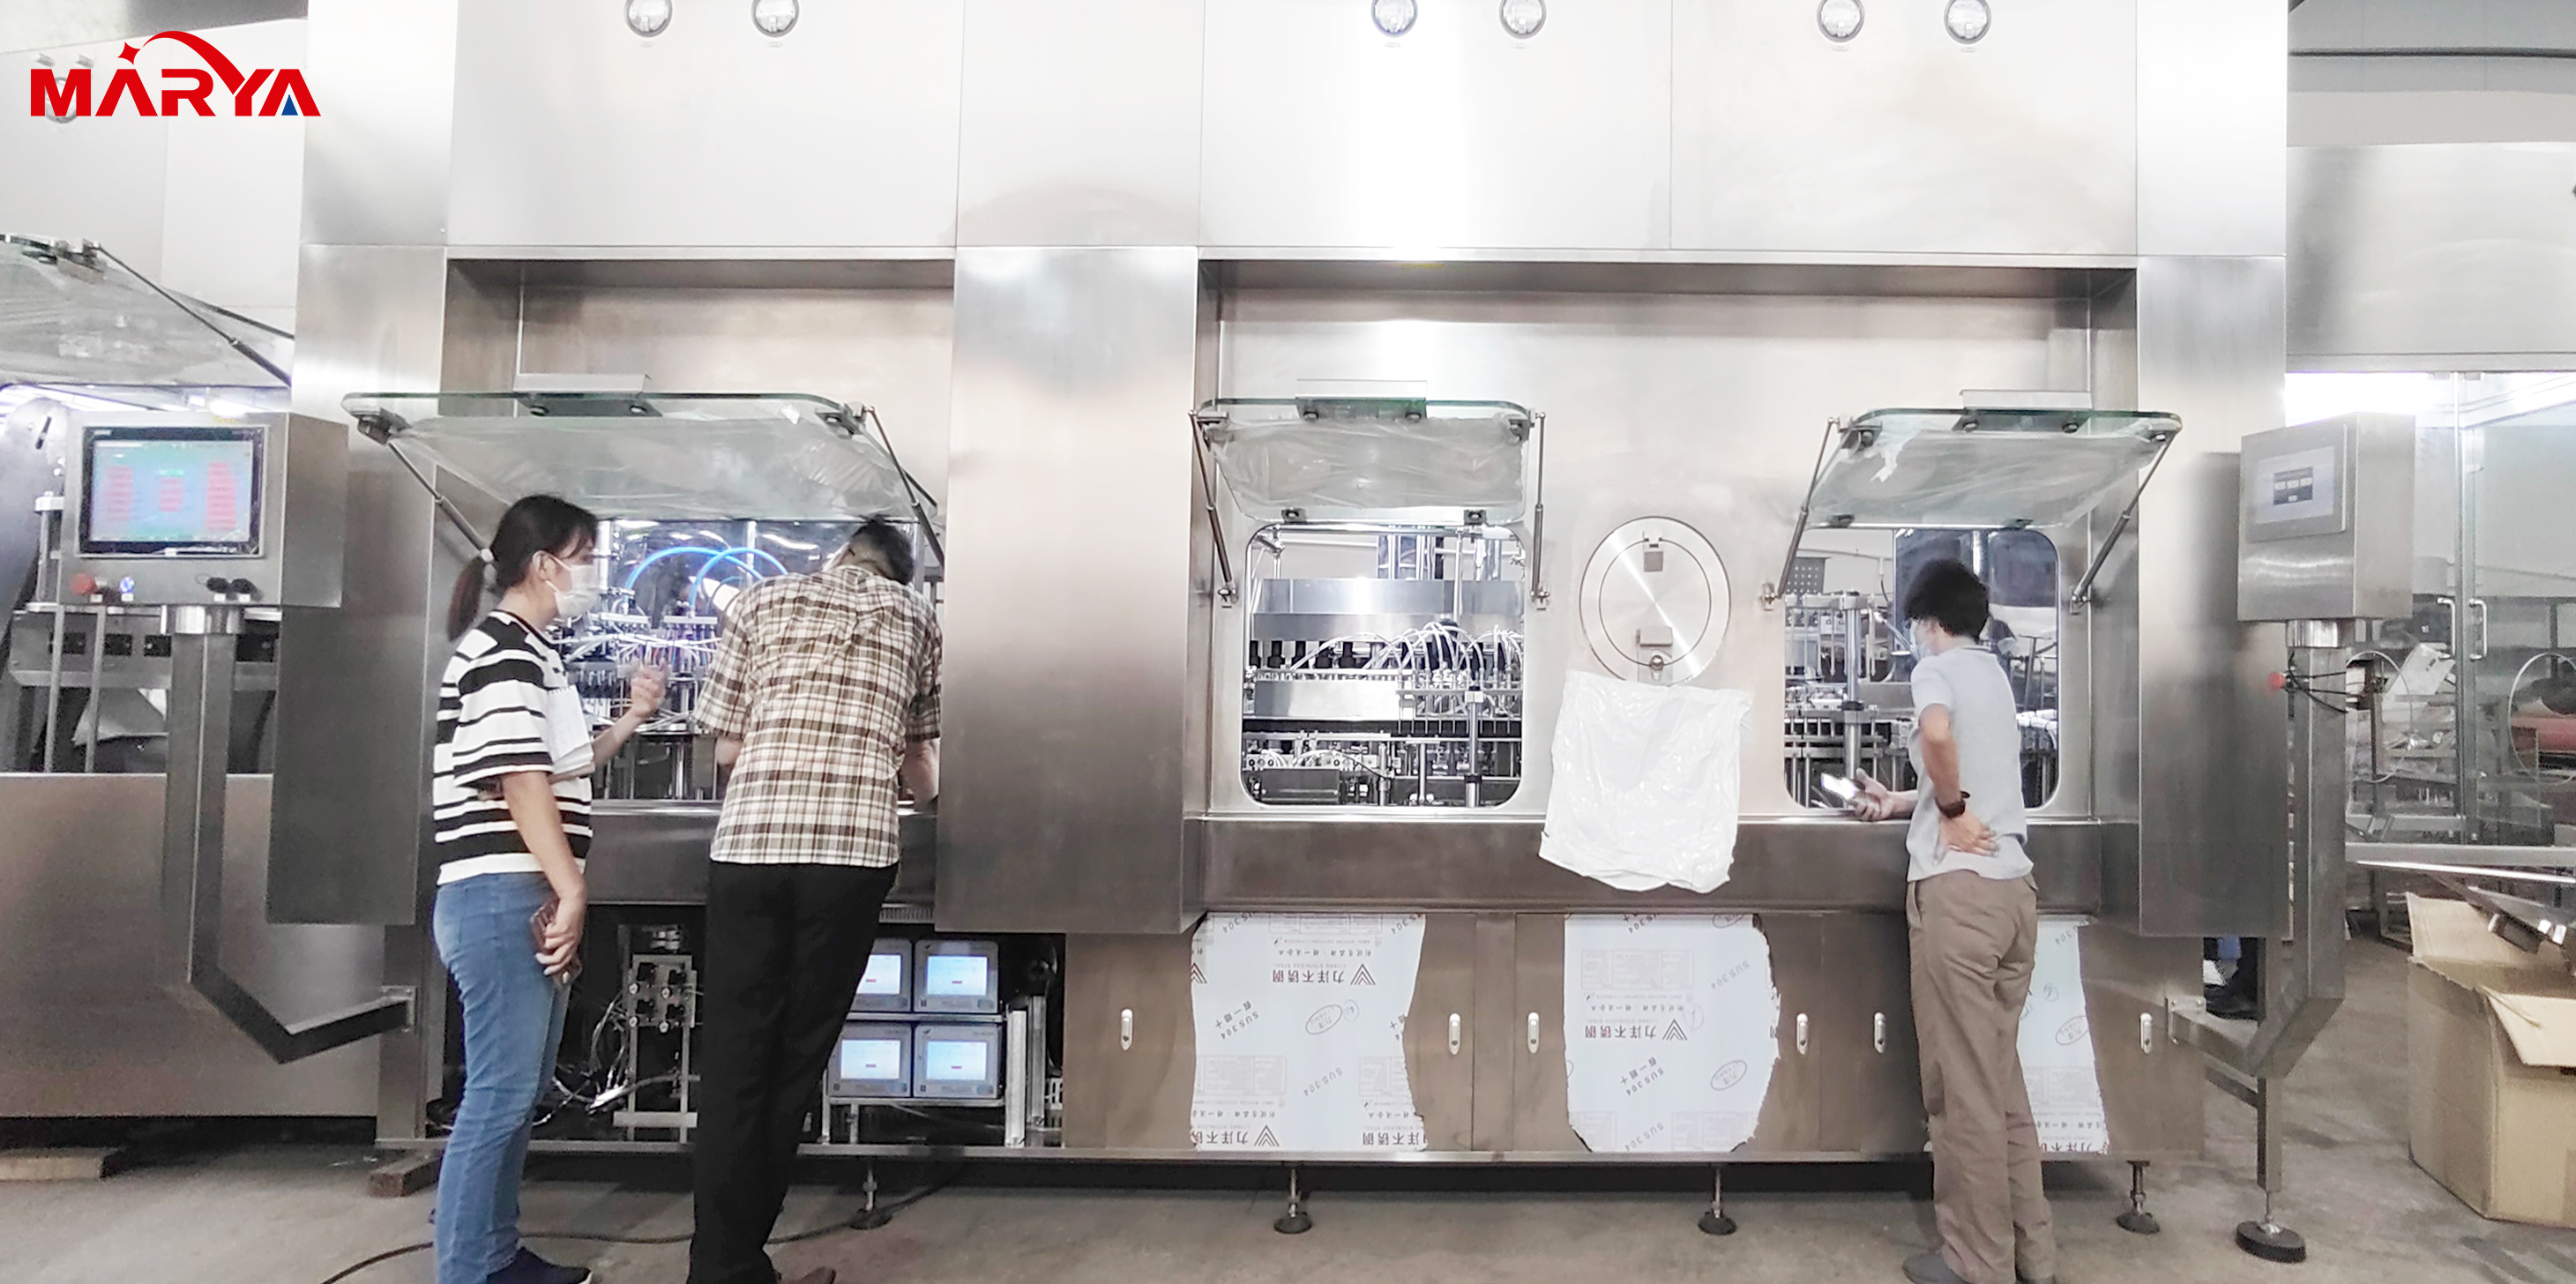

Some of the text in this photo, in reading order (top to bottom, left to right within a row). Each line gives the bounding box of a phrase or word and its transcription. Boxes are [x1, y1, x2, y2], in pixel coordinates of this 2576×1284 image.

[1272, 969, 1345, 984] 力洋不锈钢
[1585, 1025, 1656, 1039] 力洋不锈钢
